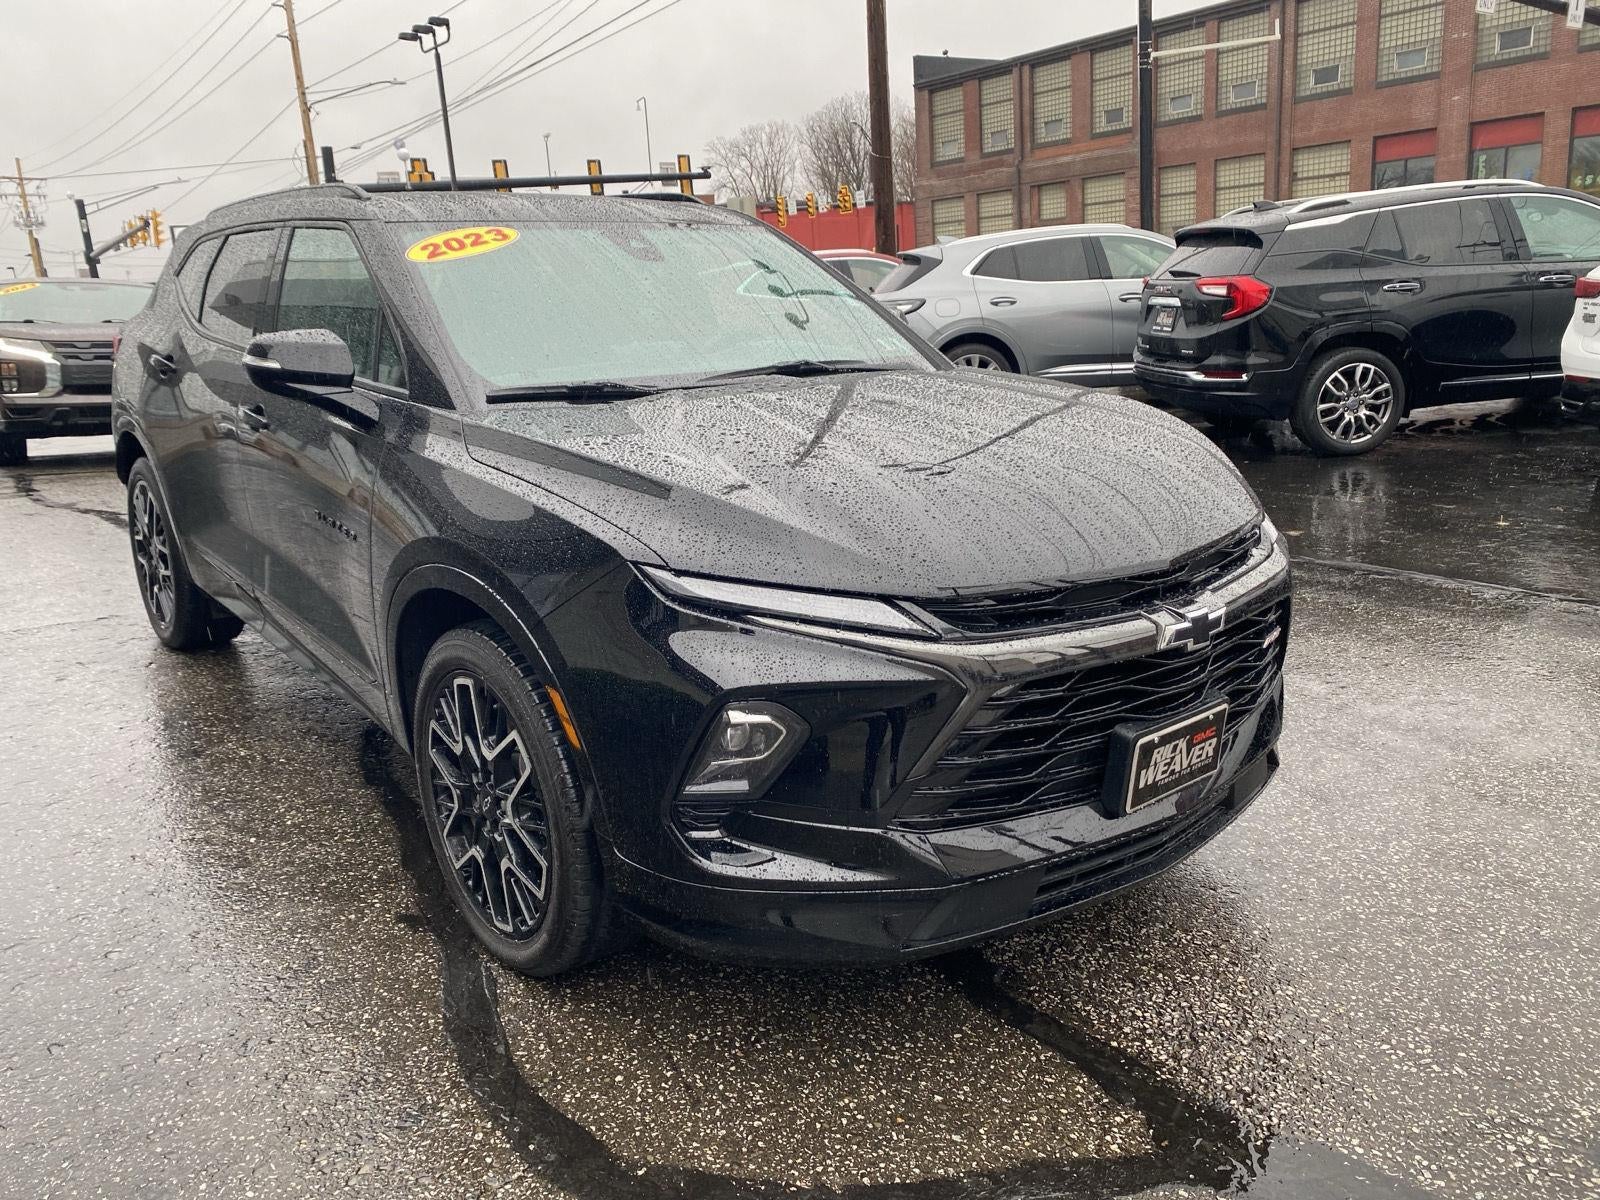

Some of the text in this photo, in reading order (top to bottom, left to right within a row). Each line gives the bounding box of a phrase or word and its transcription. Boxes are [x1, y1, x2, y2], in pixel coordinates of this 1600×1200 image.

[420, 228, 511, 260] 2023
[1192, 727, 1217, 744] GMC
[1139, 737, 1218, 789] WEAVER
[1150, 736, 1190, 767] RICK
